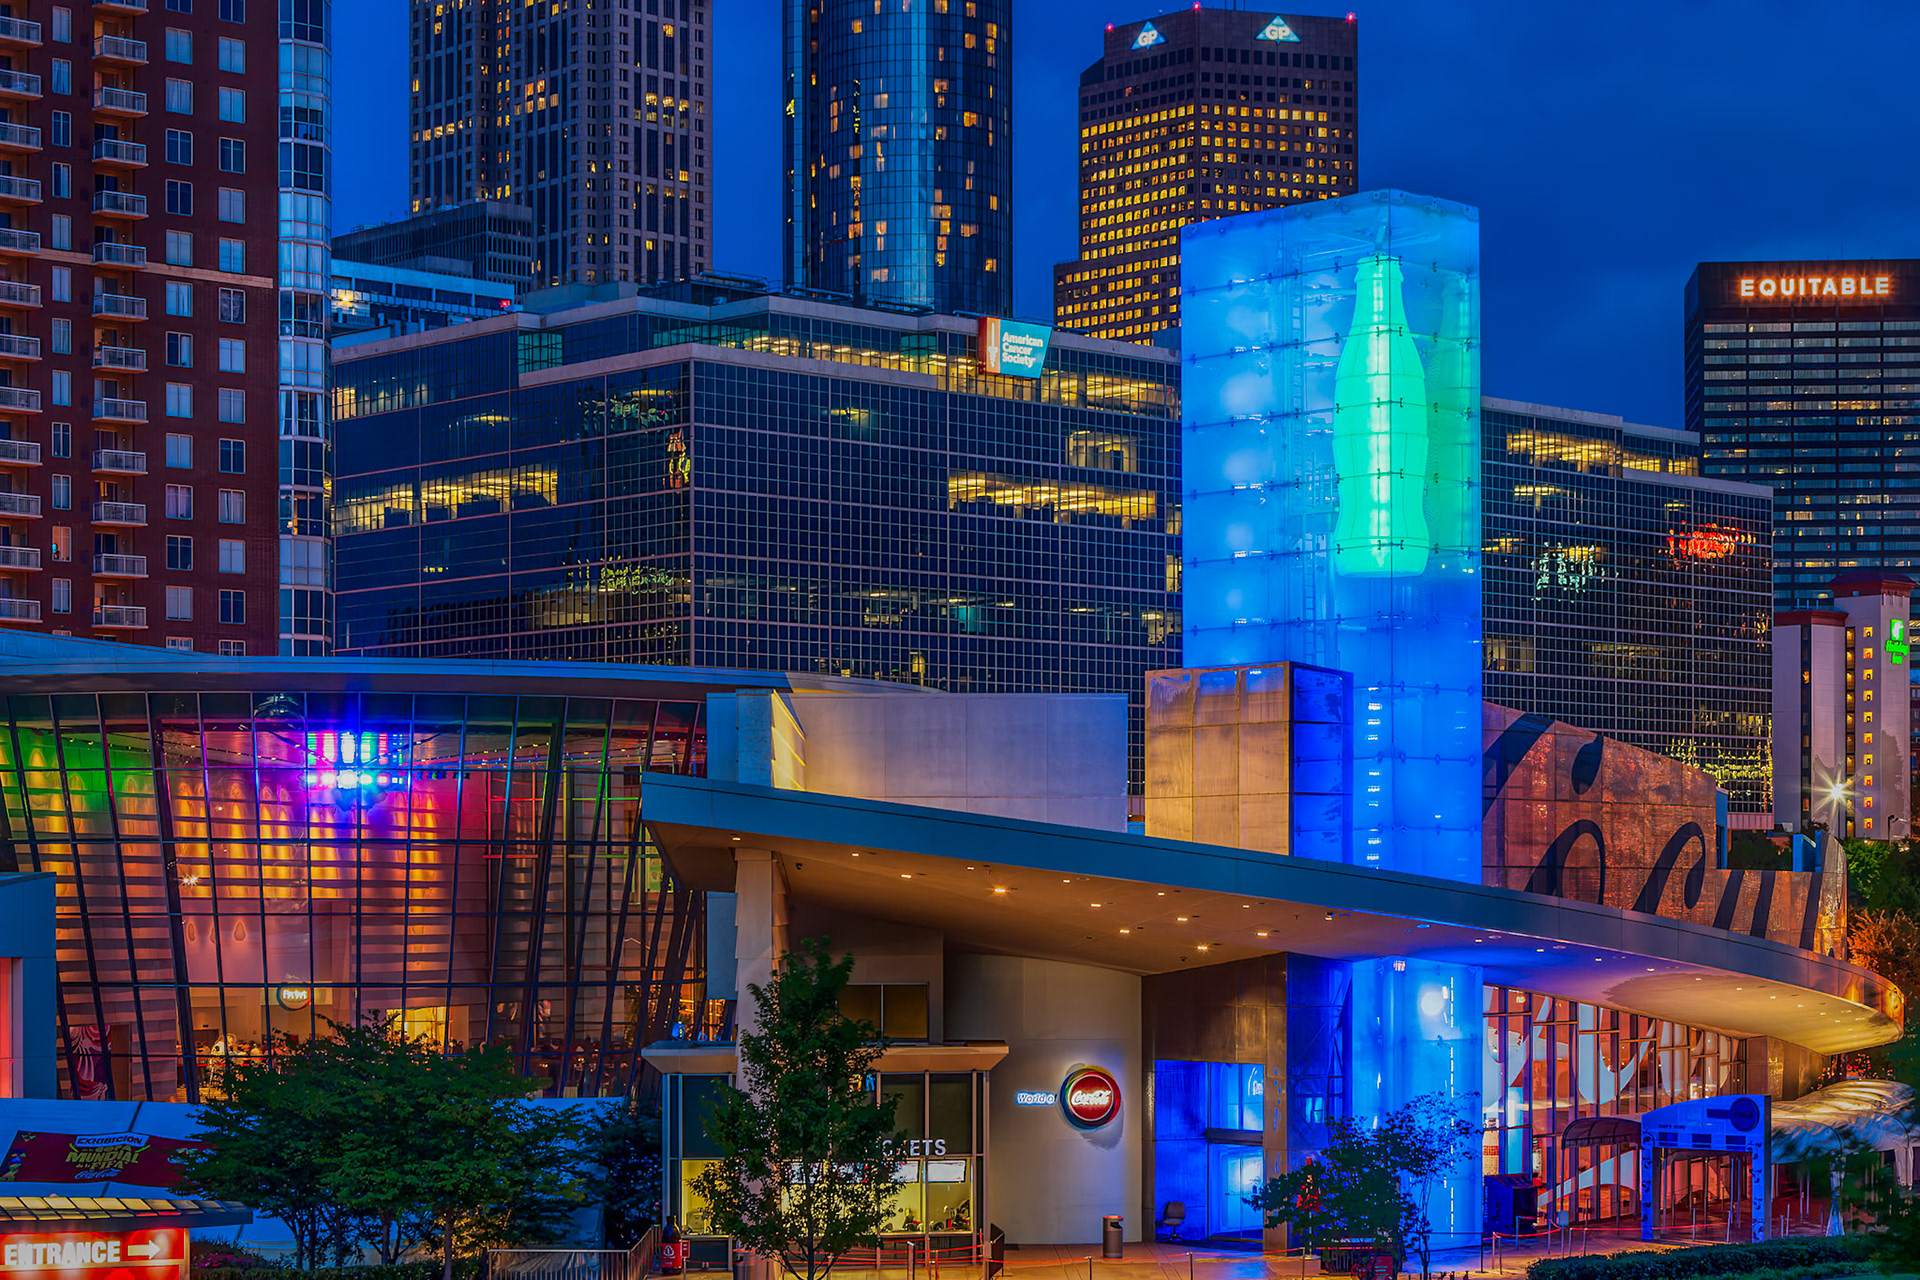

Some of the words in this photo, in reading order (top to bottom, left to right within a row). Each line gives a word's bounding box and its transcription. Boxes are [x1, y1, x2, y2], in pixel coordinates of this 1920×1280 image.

[1138, 29, 1158, 46] GP
[1265, 25, 1290, 40] GP
[1740, 277, 1889, 296] EQUITABLE
[1002, 332, 1043, 347] American
[1002, 342, 1032, 355] Cancer
[1002, 352, 1036, 368] Society
[1018, 1092, 1045, 1104] World
[65, 1150, 139, 1163] MUNDIAL
[90, 1160, 123, 1169] FIFA
[4, 1241, 121, 1266] ENTRANCE
